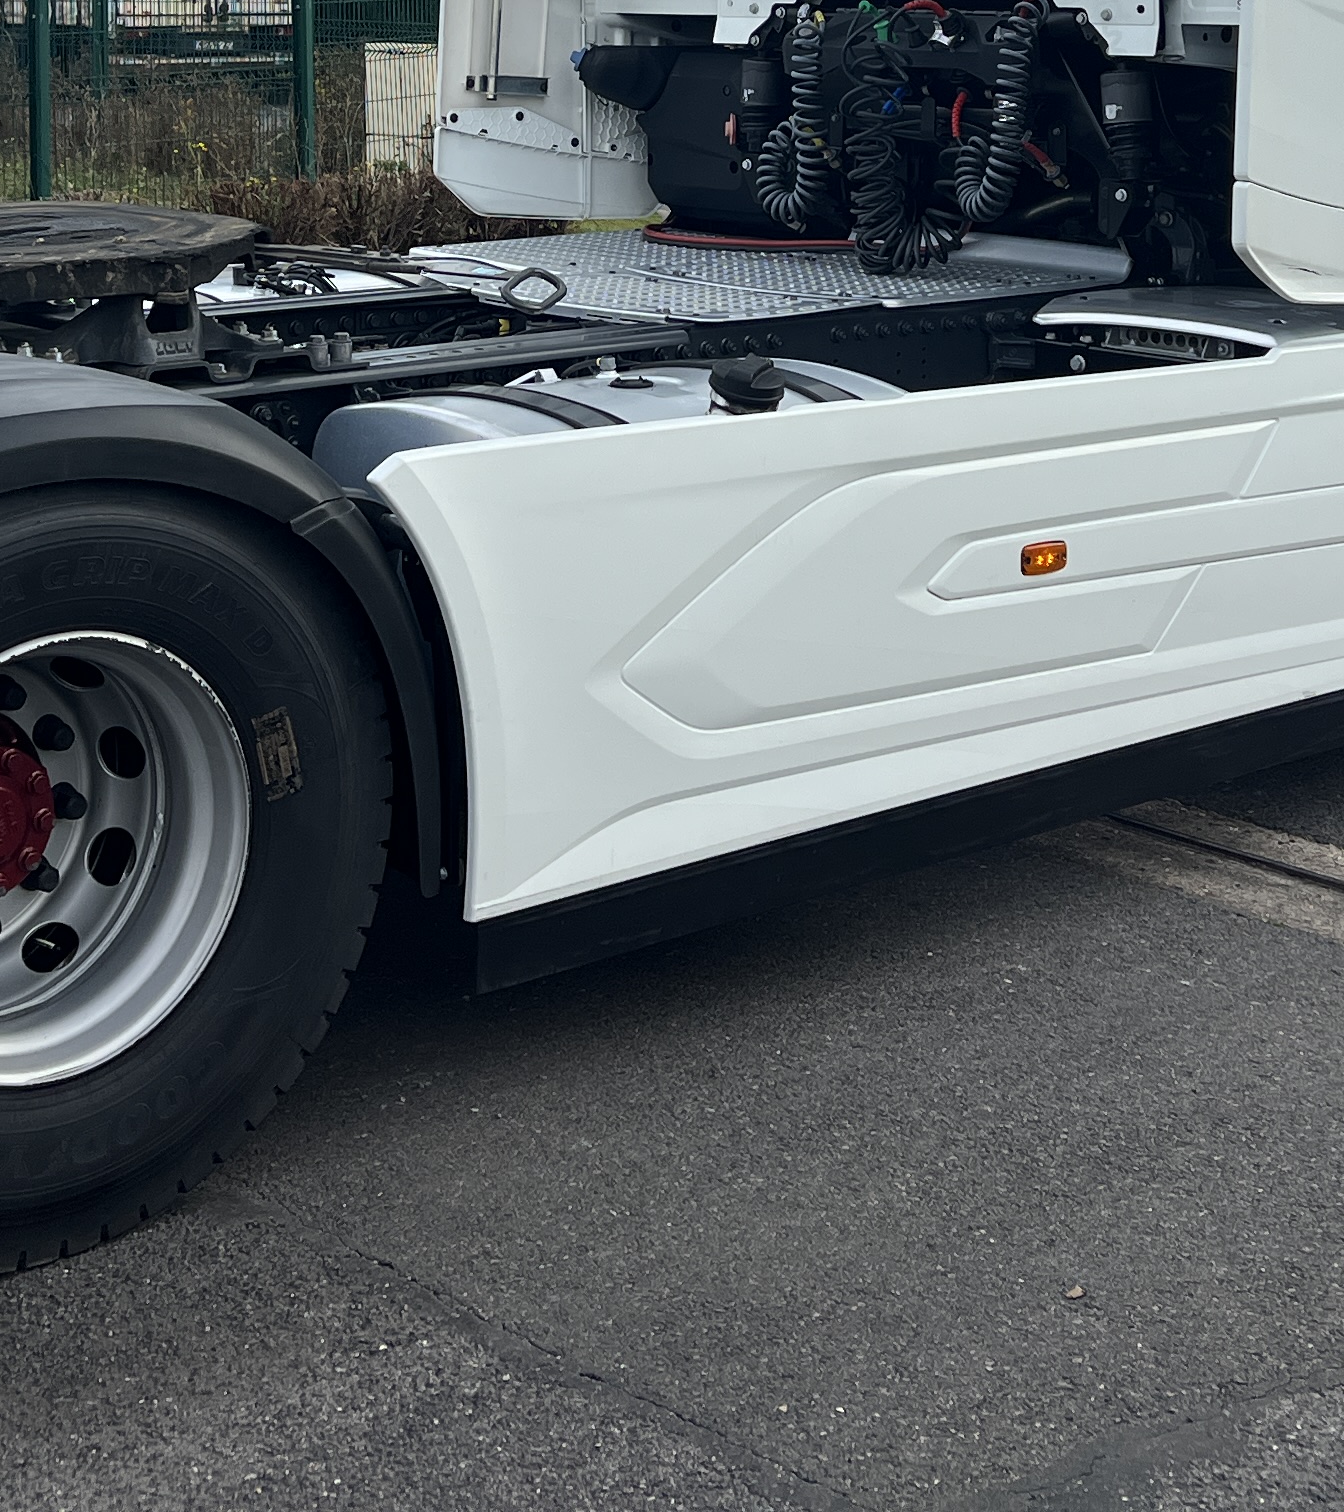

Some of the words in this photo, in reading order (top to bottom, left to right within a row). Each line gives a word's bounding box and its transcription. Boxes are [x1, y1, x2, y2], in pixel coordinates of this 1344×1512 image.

[41, 555, 153, 591] GRIP
[156, 565, 248, 631] MAX
[239, 624, 274, 657] D
